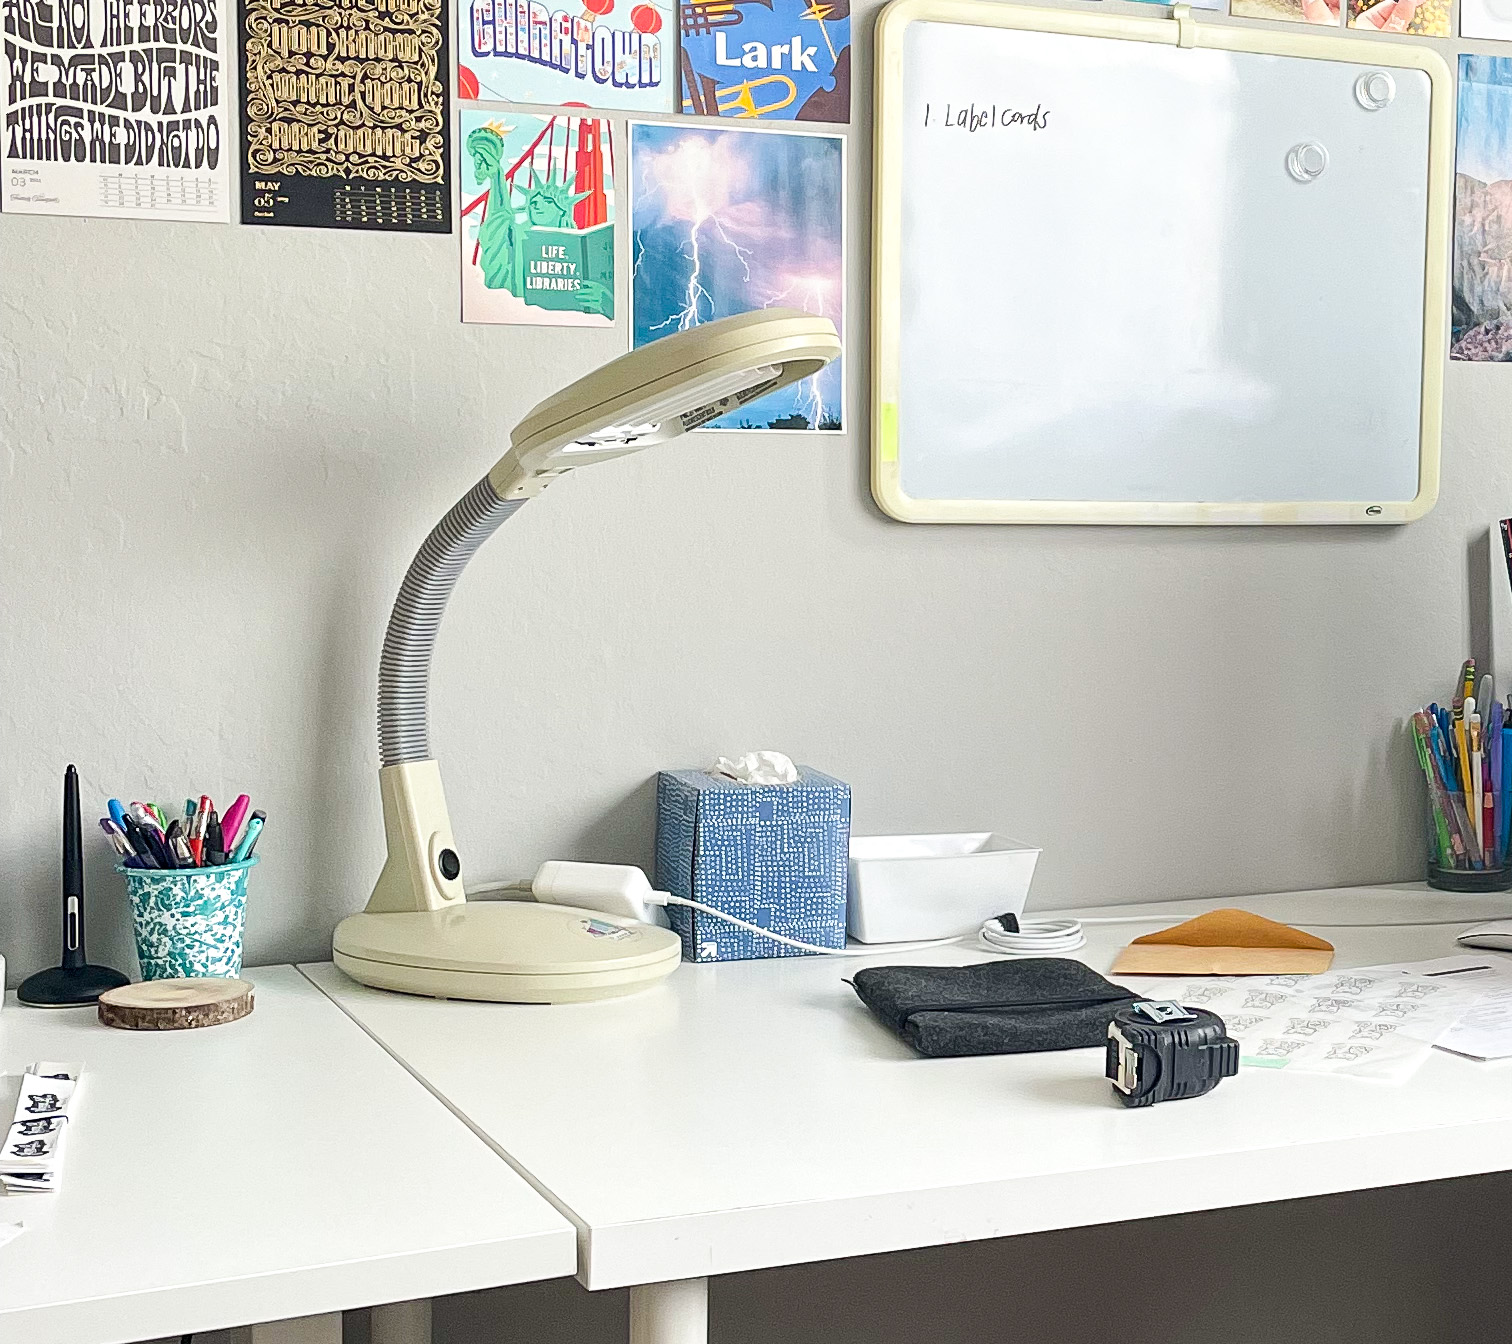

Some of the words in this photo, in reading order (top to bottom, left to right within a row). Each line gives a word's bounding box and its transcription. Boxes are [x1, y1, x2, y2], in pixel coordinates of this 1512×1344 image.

[271, 22, 329, 59] YOU
[338, 27, 422, 62] KNOW
[714, 30, 820, 75] Lark
[4, 37, 50, 107] WE
[50, 49, 130, 113] MADE
[129, 46, 178, 116] BUT
[179, 47, 220, 116] THE
[271, 71, 356, 106] WHAT
[364, 77, 420, 114] YOU
[6, 102, 87, 163] THINGS
[87, 109, 122, 166] WE
[123, 116, 156, 167] DID
[157, 117, 194, 170] NOT
[194, 114, 220, 171] DO
[944, 102, 996, 133] Label
[271, 119, 327, 153] ARE
[337, 124, 422, 159] DOING
[254, 180, 282, 191] MAY
[254, 192, 274, 208] 05
[525, 274, 582, 293] LIBRARIES
